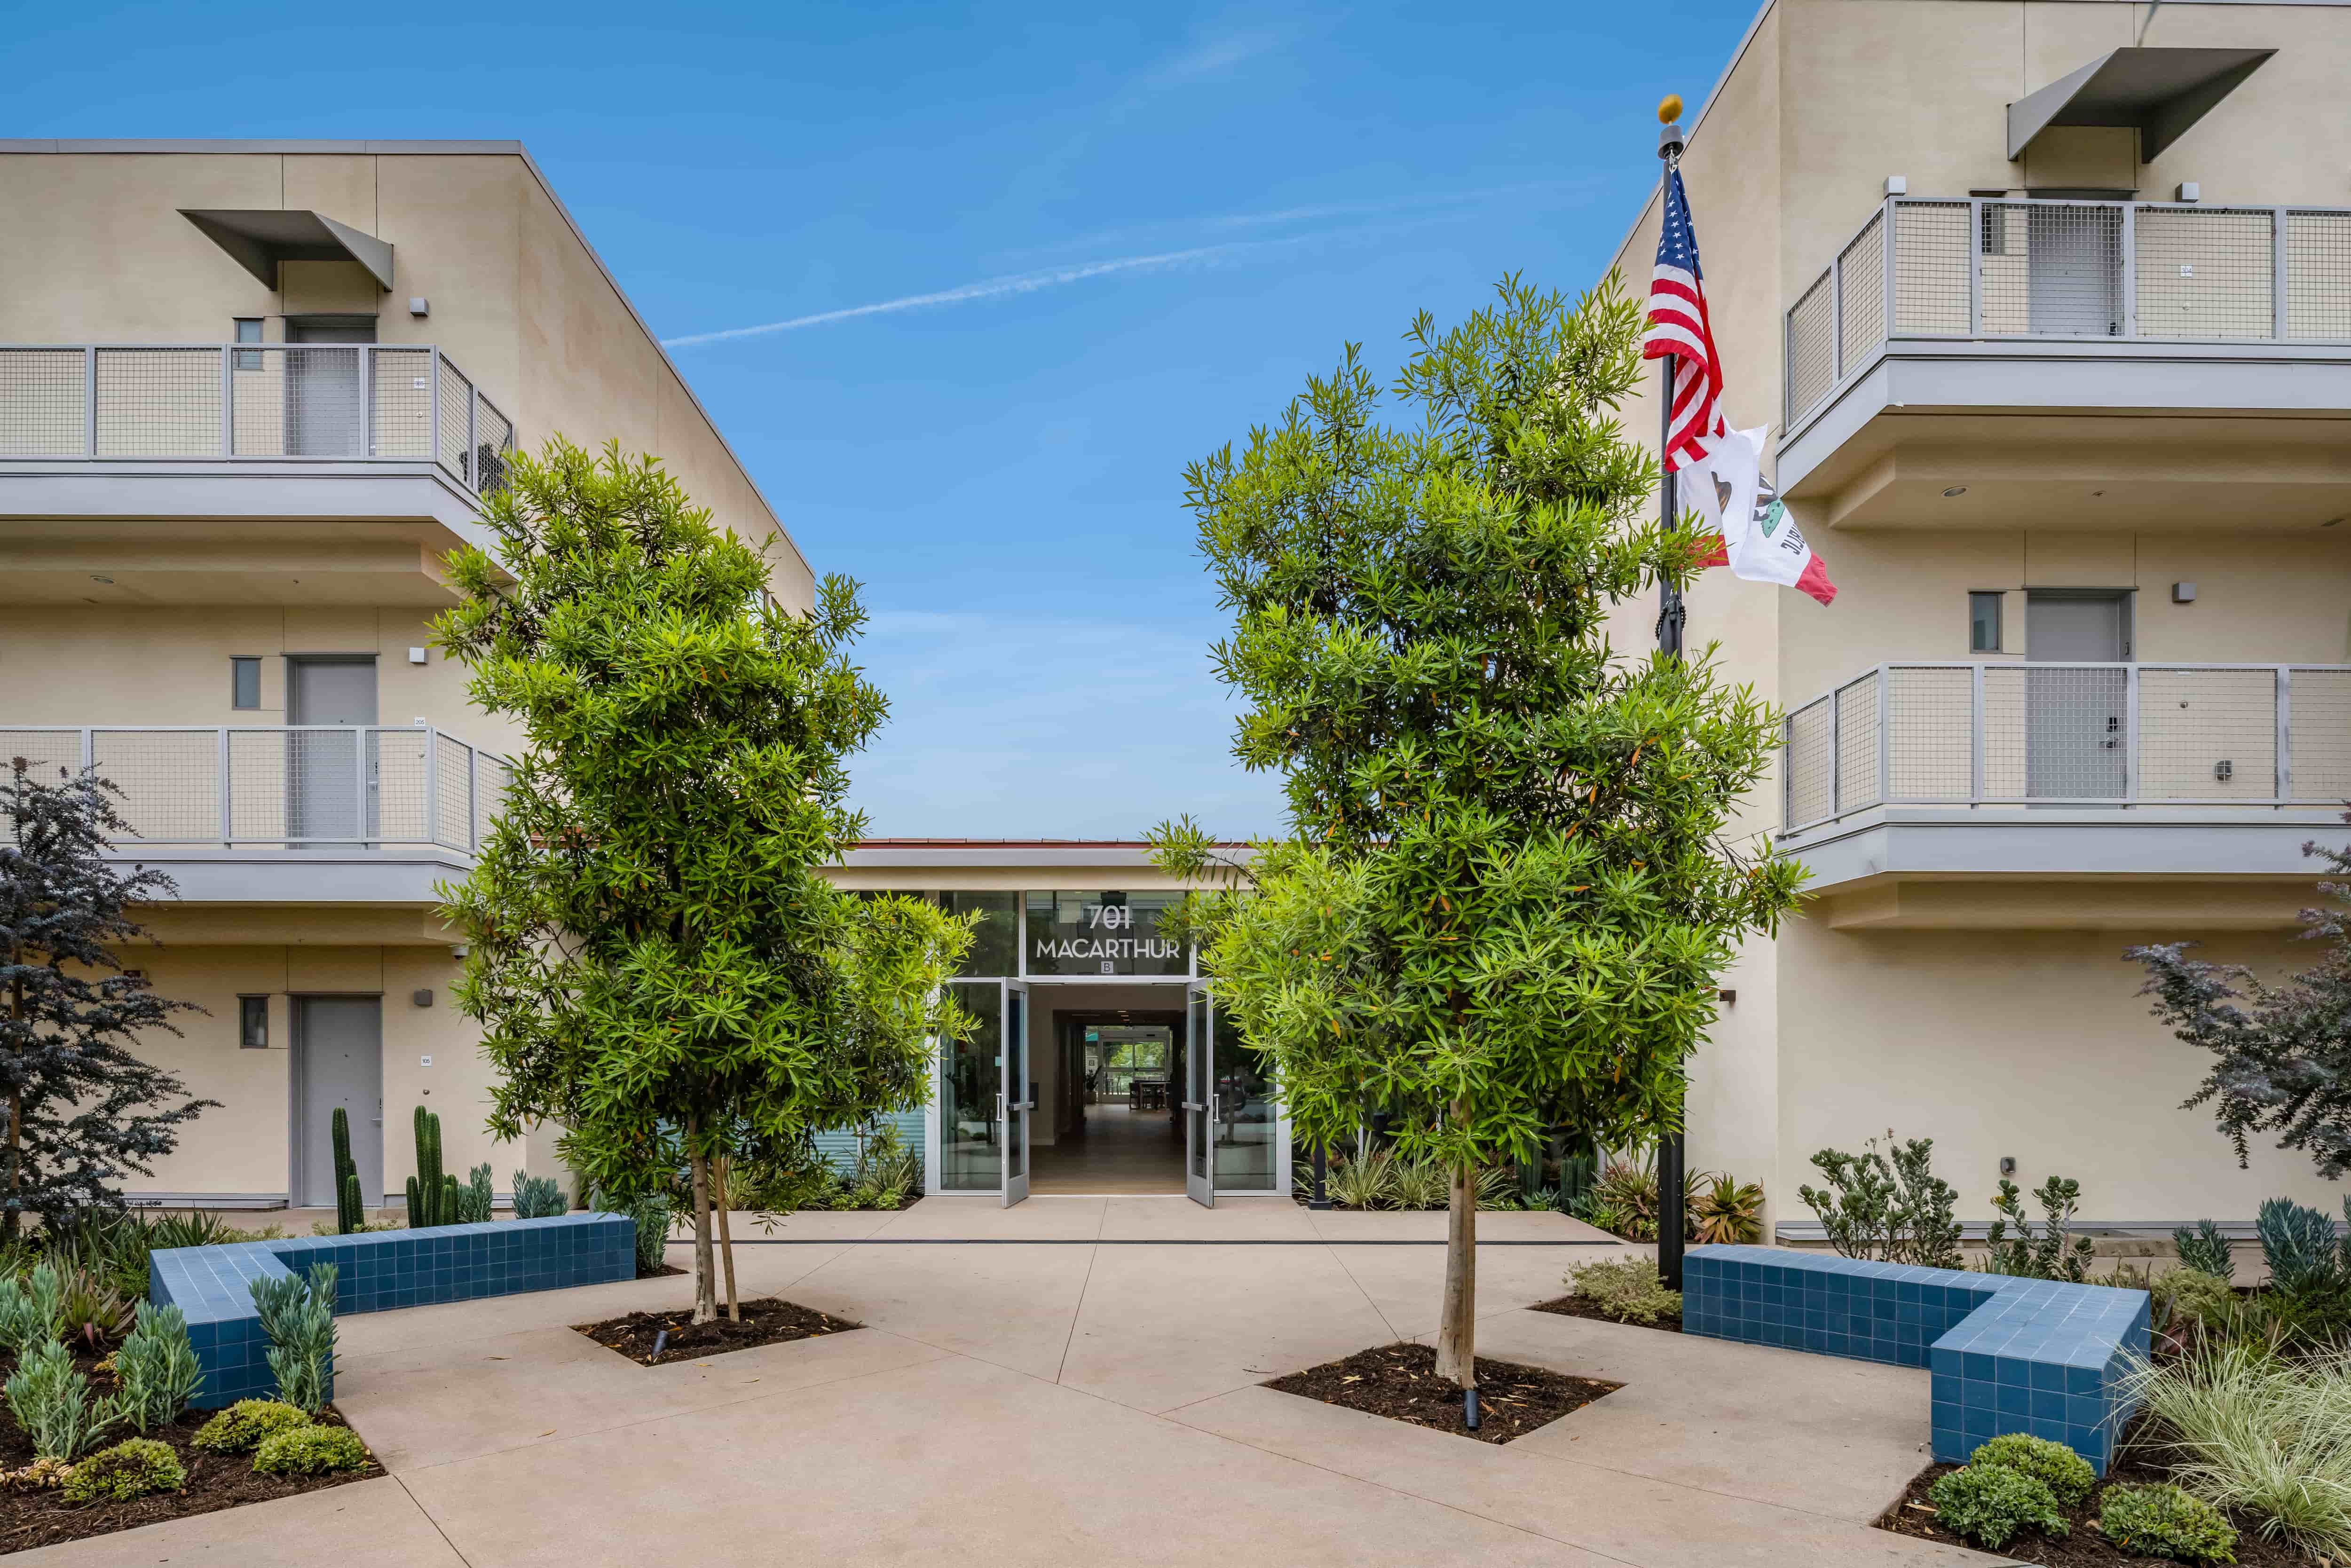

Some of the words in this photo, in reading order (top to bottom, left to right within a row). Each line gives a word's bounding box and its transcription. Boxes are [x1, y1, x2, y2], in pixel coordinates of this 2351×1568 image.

[1087, 905, 1129, 929] 701
[1036, 939, 1180, 958] MACARTHUR
[1104, 963, 1110, 972] B
